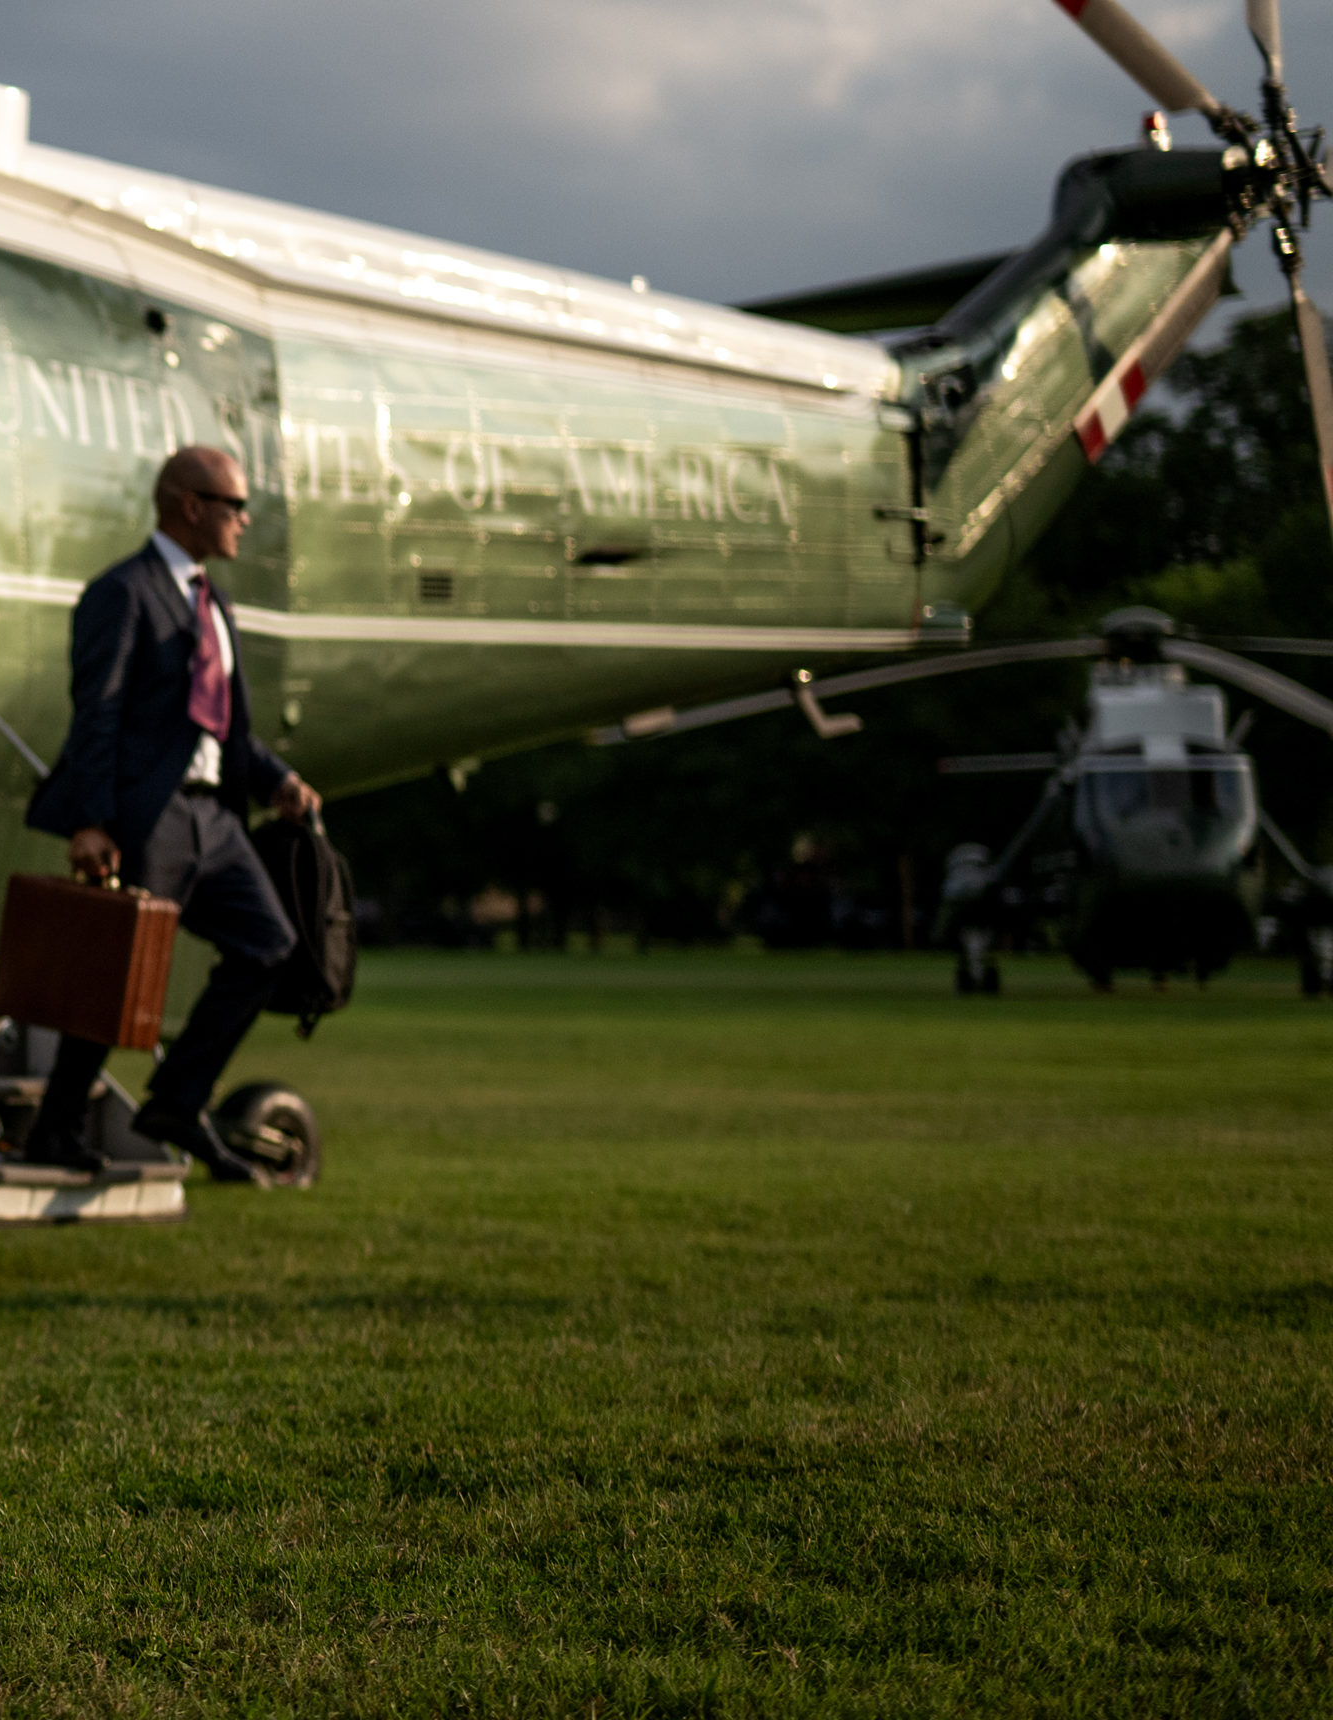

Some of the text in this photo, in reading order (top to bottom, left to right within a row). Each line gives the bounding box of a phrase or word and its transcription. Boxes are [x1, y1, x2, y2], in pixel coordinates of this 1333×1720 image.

[216, 392, 410, 504] STATES
[445, 441, 512, 511] OF
[559, 445, 795, 525] AMERICA
